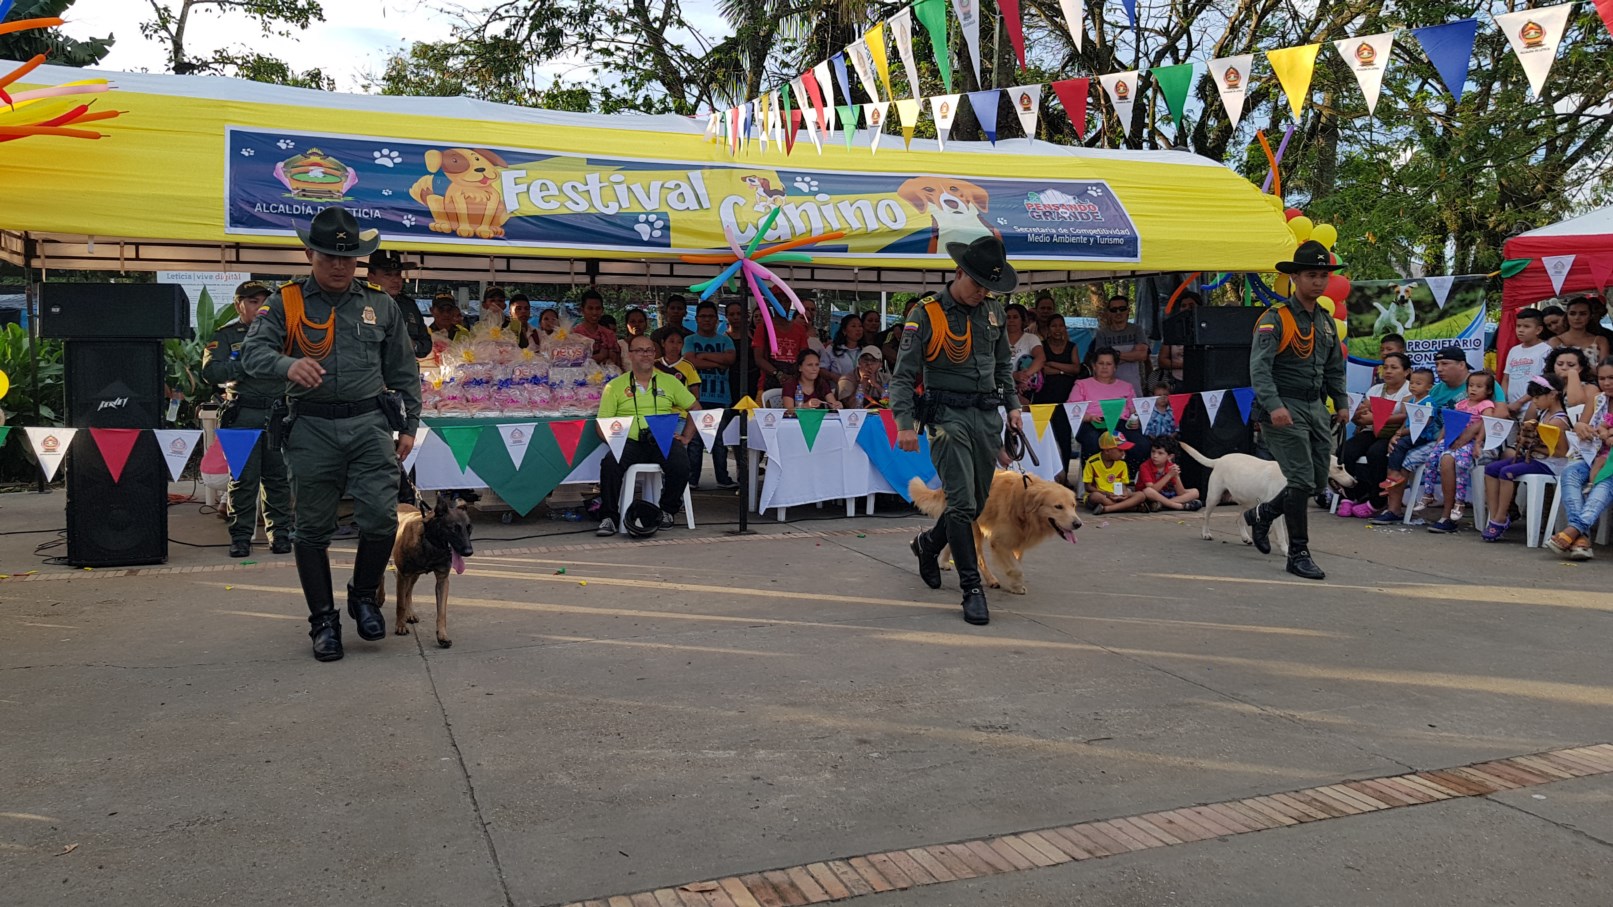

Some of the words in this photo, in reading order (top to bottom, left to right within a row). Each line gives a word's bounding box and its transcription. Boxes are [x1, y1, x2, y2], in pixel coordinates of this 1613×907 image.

[254, 202, 313, 215] ALCALDÍA
[501, 169, 711, 215] Festival
[719, 193, 907, 245] Canino
[1025, 202, 1098, 212] PENSANDO
[1029, 210, 1104, 220] GRANDE
[1070, 227, 1130, 235] Competitividad
[1027, 233, 1050, 242] Medio
[1053, 234, 1088, 244] Ambiente
[1089, 236, 1094, 246] y
[1096, 235, 1125, 245] Turismo
[166, 272, 192, 280] Leticia
[215, 272, 241, 282] digital
[1407, 338, 1482, 350] PROPIETARIO
